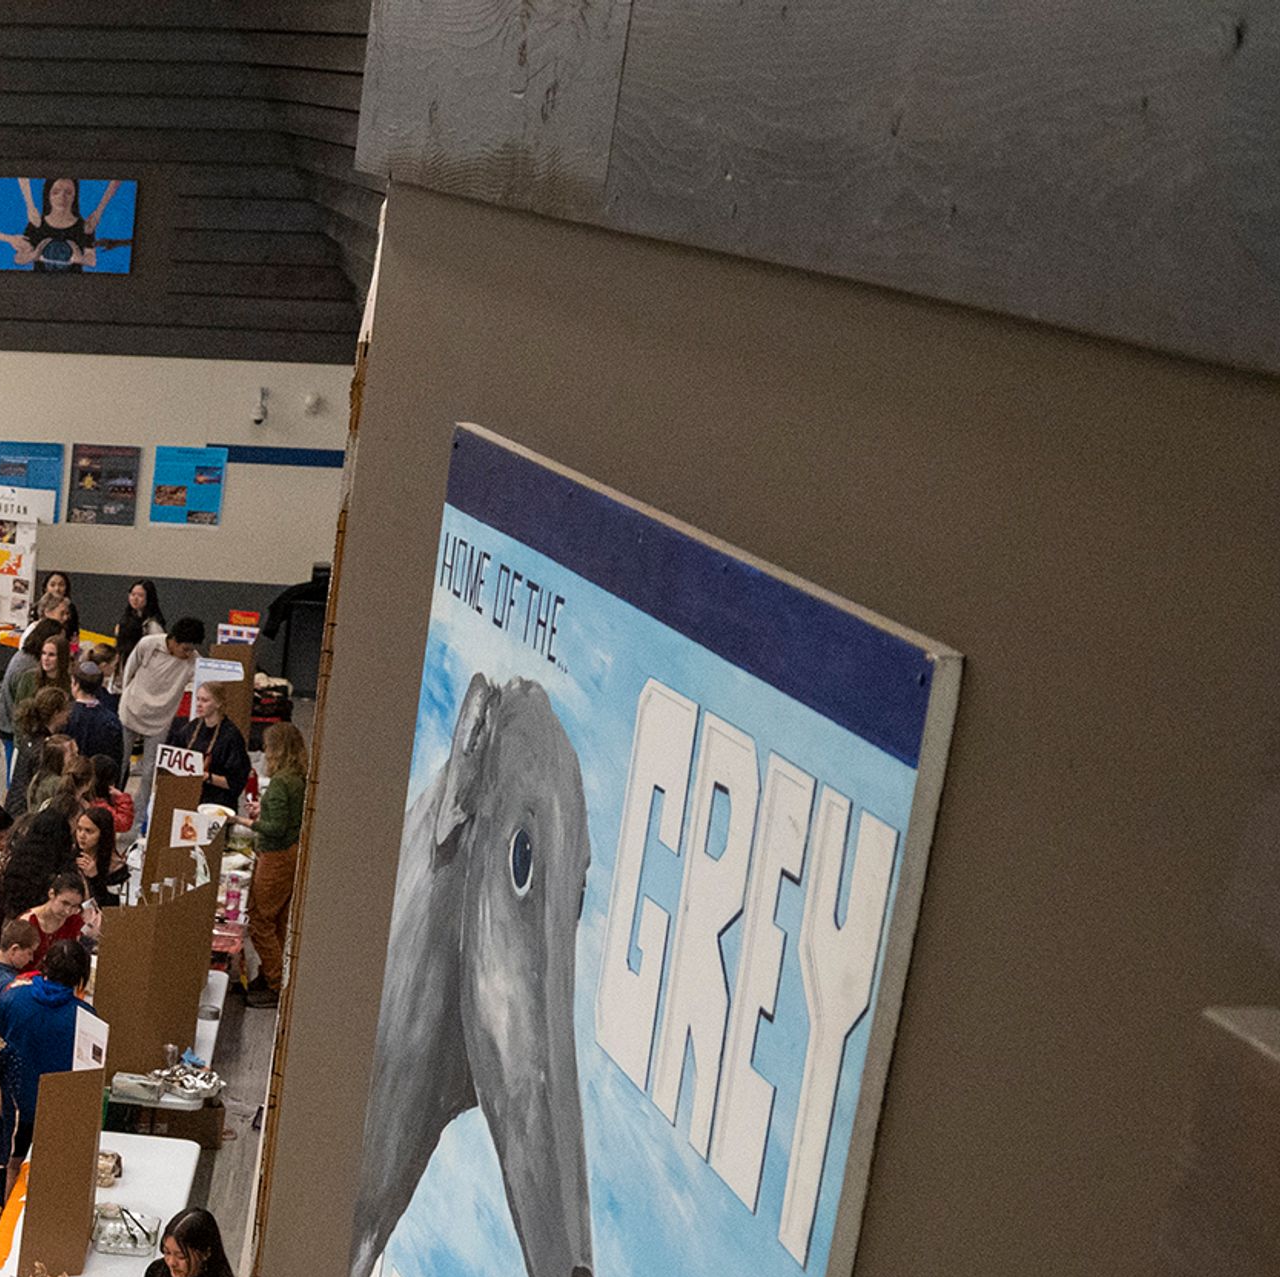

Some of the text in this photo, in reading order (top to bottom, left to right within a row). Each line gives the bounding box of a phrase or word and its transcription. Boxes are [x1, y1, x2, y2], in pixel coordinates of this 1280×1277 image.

[440, 532, 491, 615] HOME
[492, 563, 523, 632] OF
[595, 676, 901, 1273] GREY
